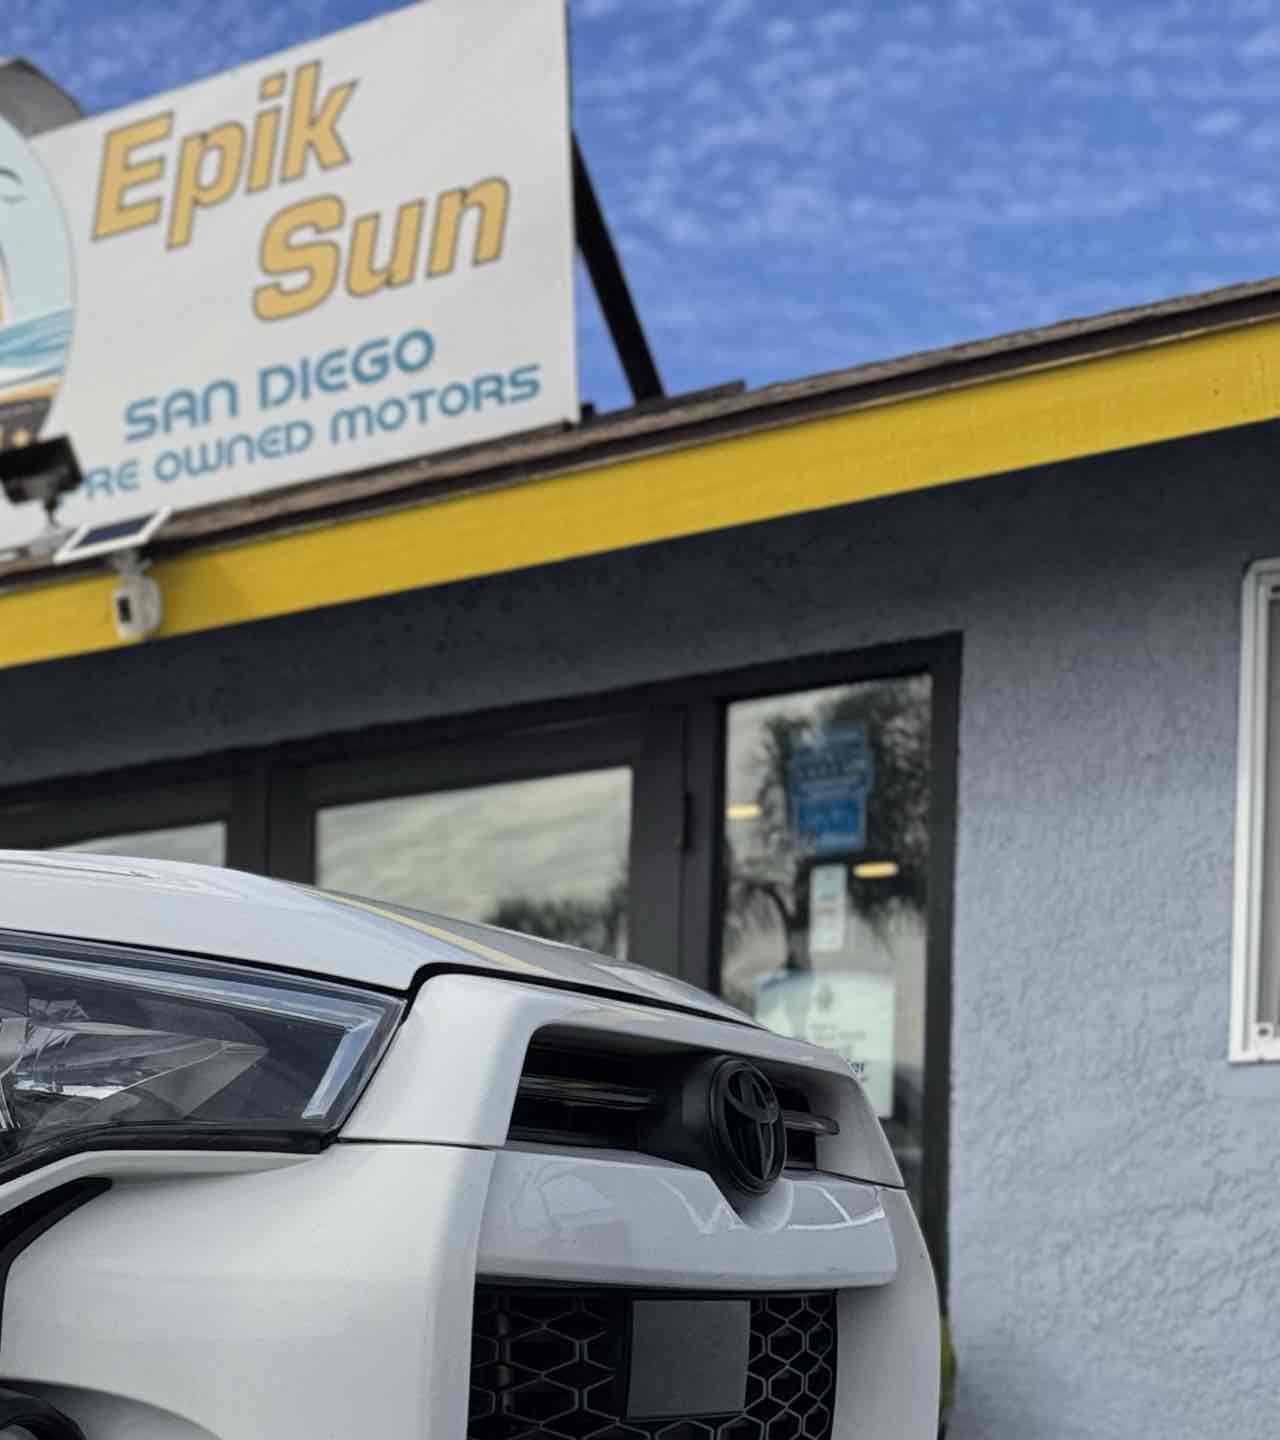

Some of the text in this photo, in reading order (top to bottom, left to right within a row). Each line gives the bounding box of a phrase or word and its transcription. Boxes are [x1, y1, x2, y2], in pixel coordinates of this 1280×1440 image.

[91, 58, 361, 252] Epik
[252, 176, 510, 322] Sun
[80, 364, 541, 500] RE OWNED MOTORS
[124, 328, 436, 443] SAN DIEGO
